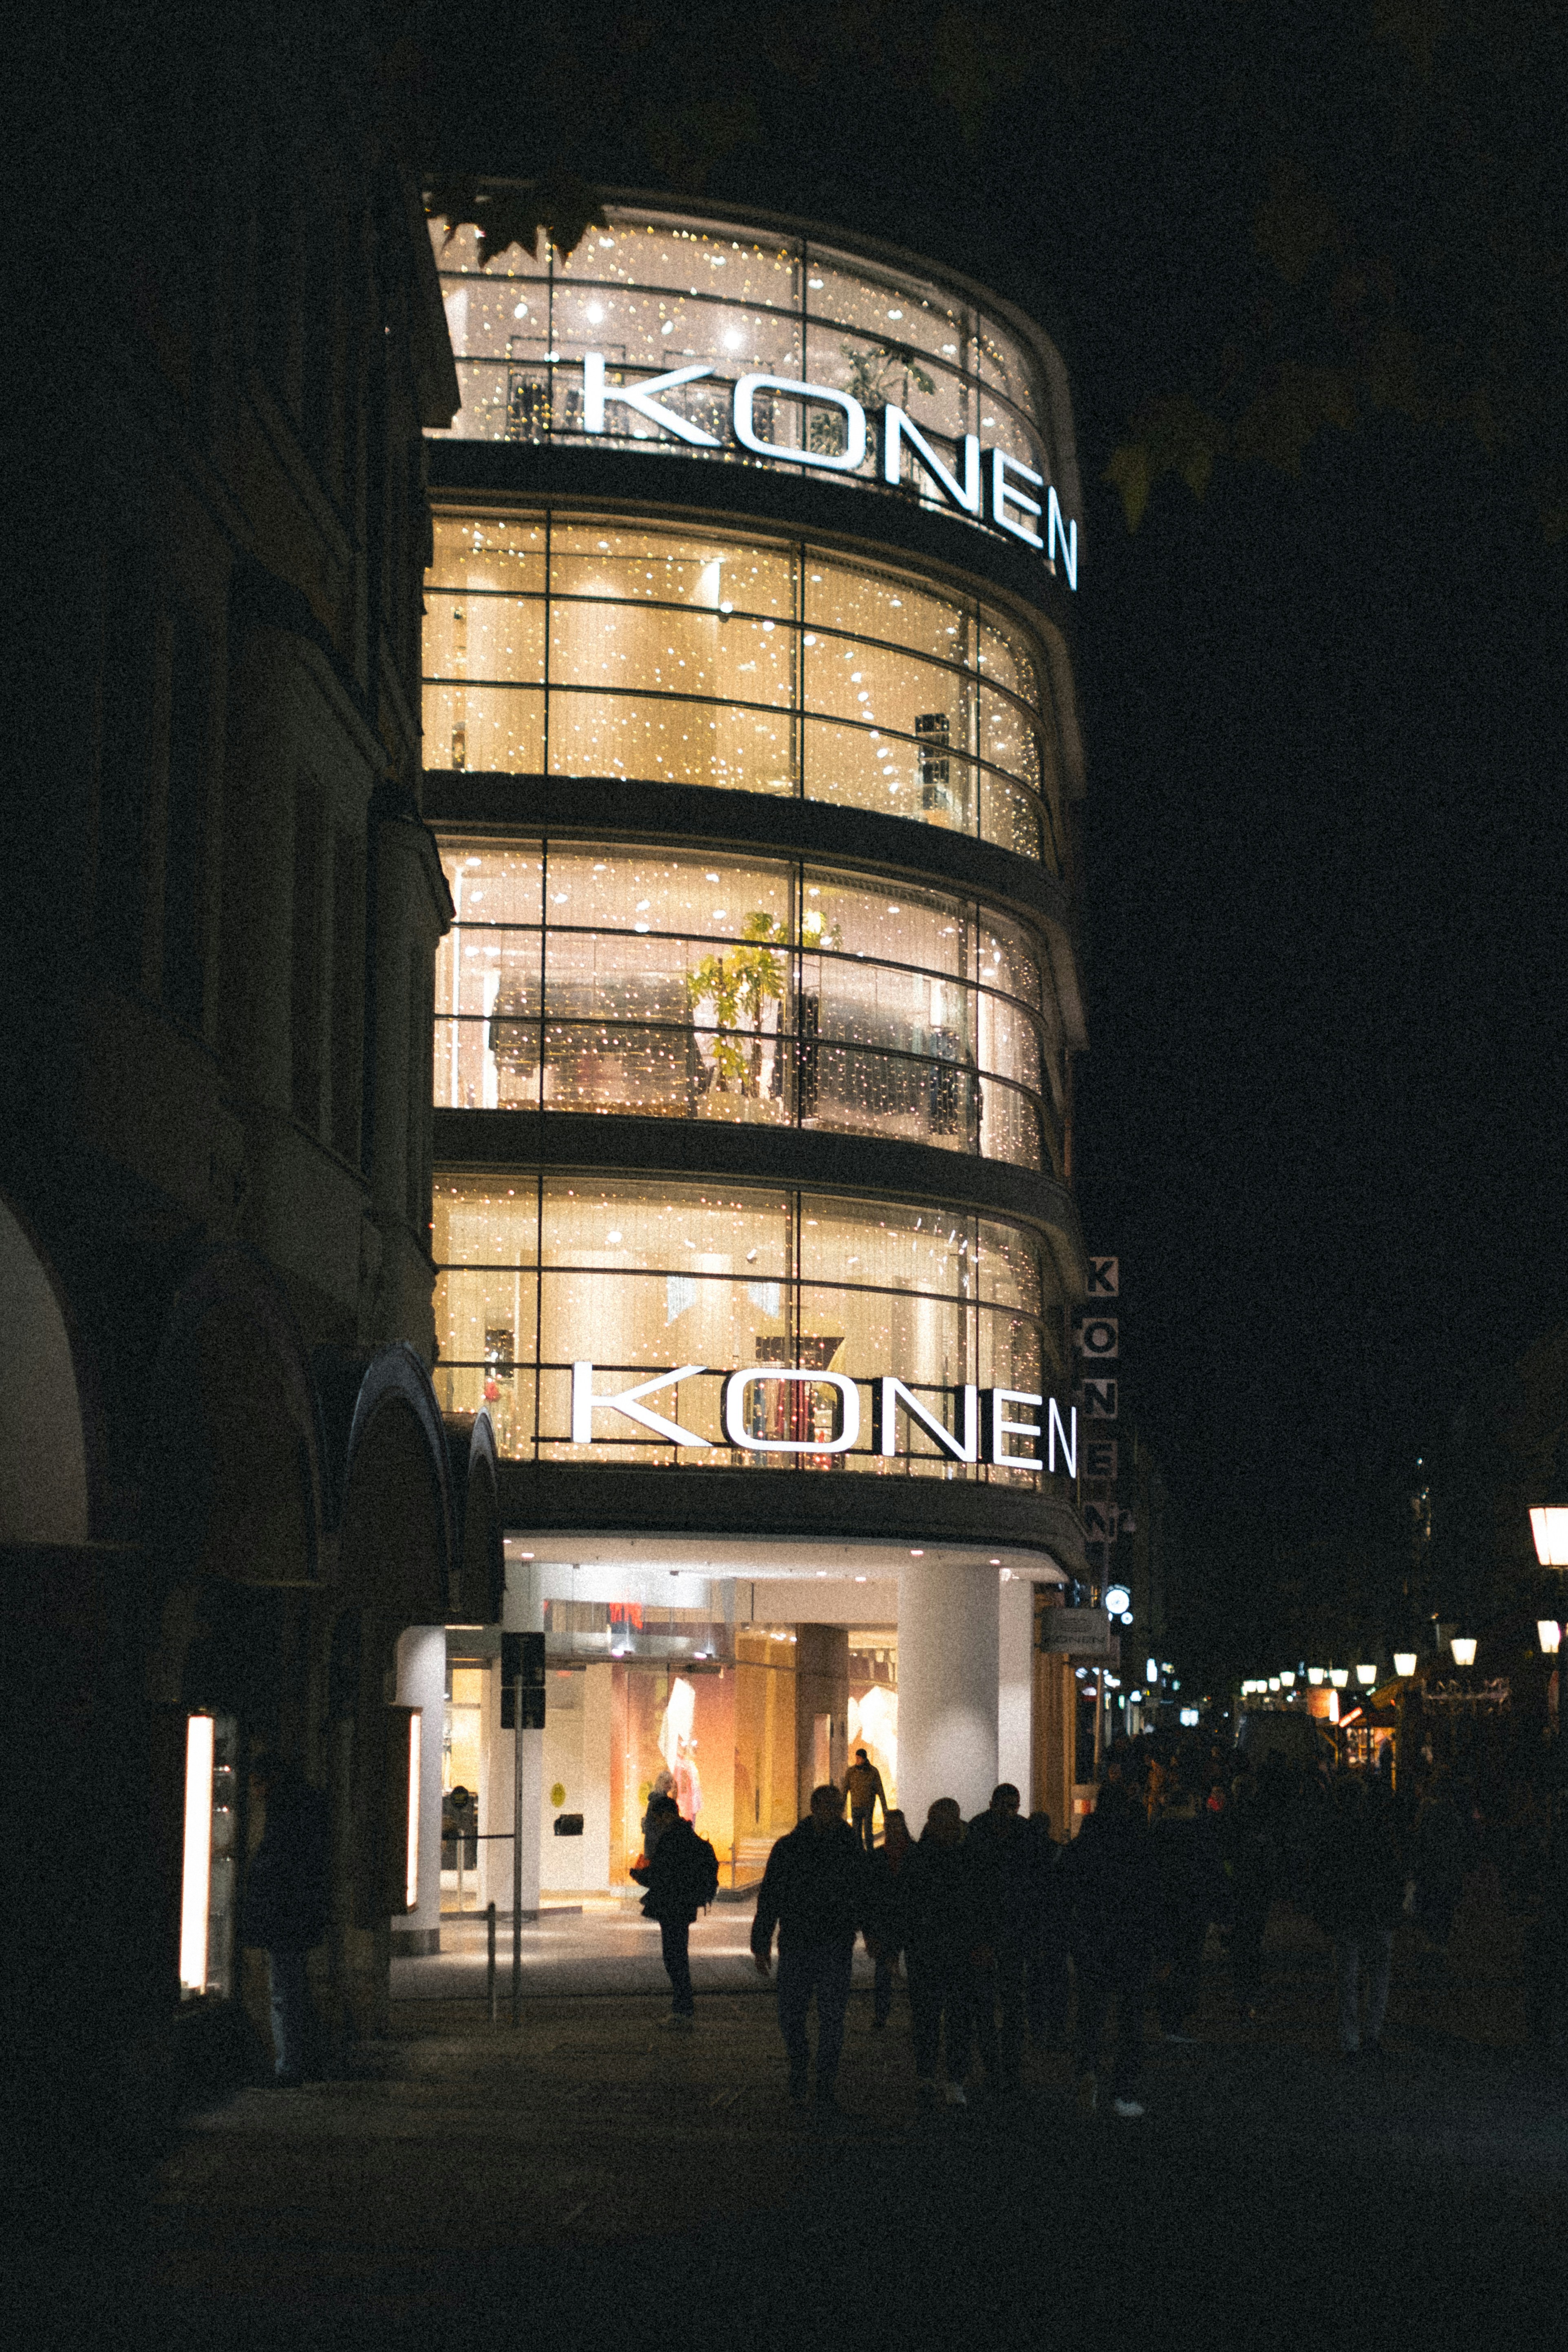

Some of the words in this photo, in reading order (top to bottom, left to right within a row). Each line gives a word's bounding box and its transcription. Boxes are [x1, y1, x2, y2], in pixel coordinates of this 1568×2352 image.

[584, 351, 1077, 591] KONEN
[572, 1361, 1076, 1478] KONEN
[1083, 1260, 1117, 1540] KONEN
